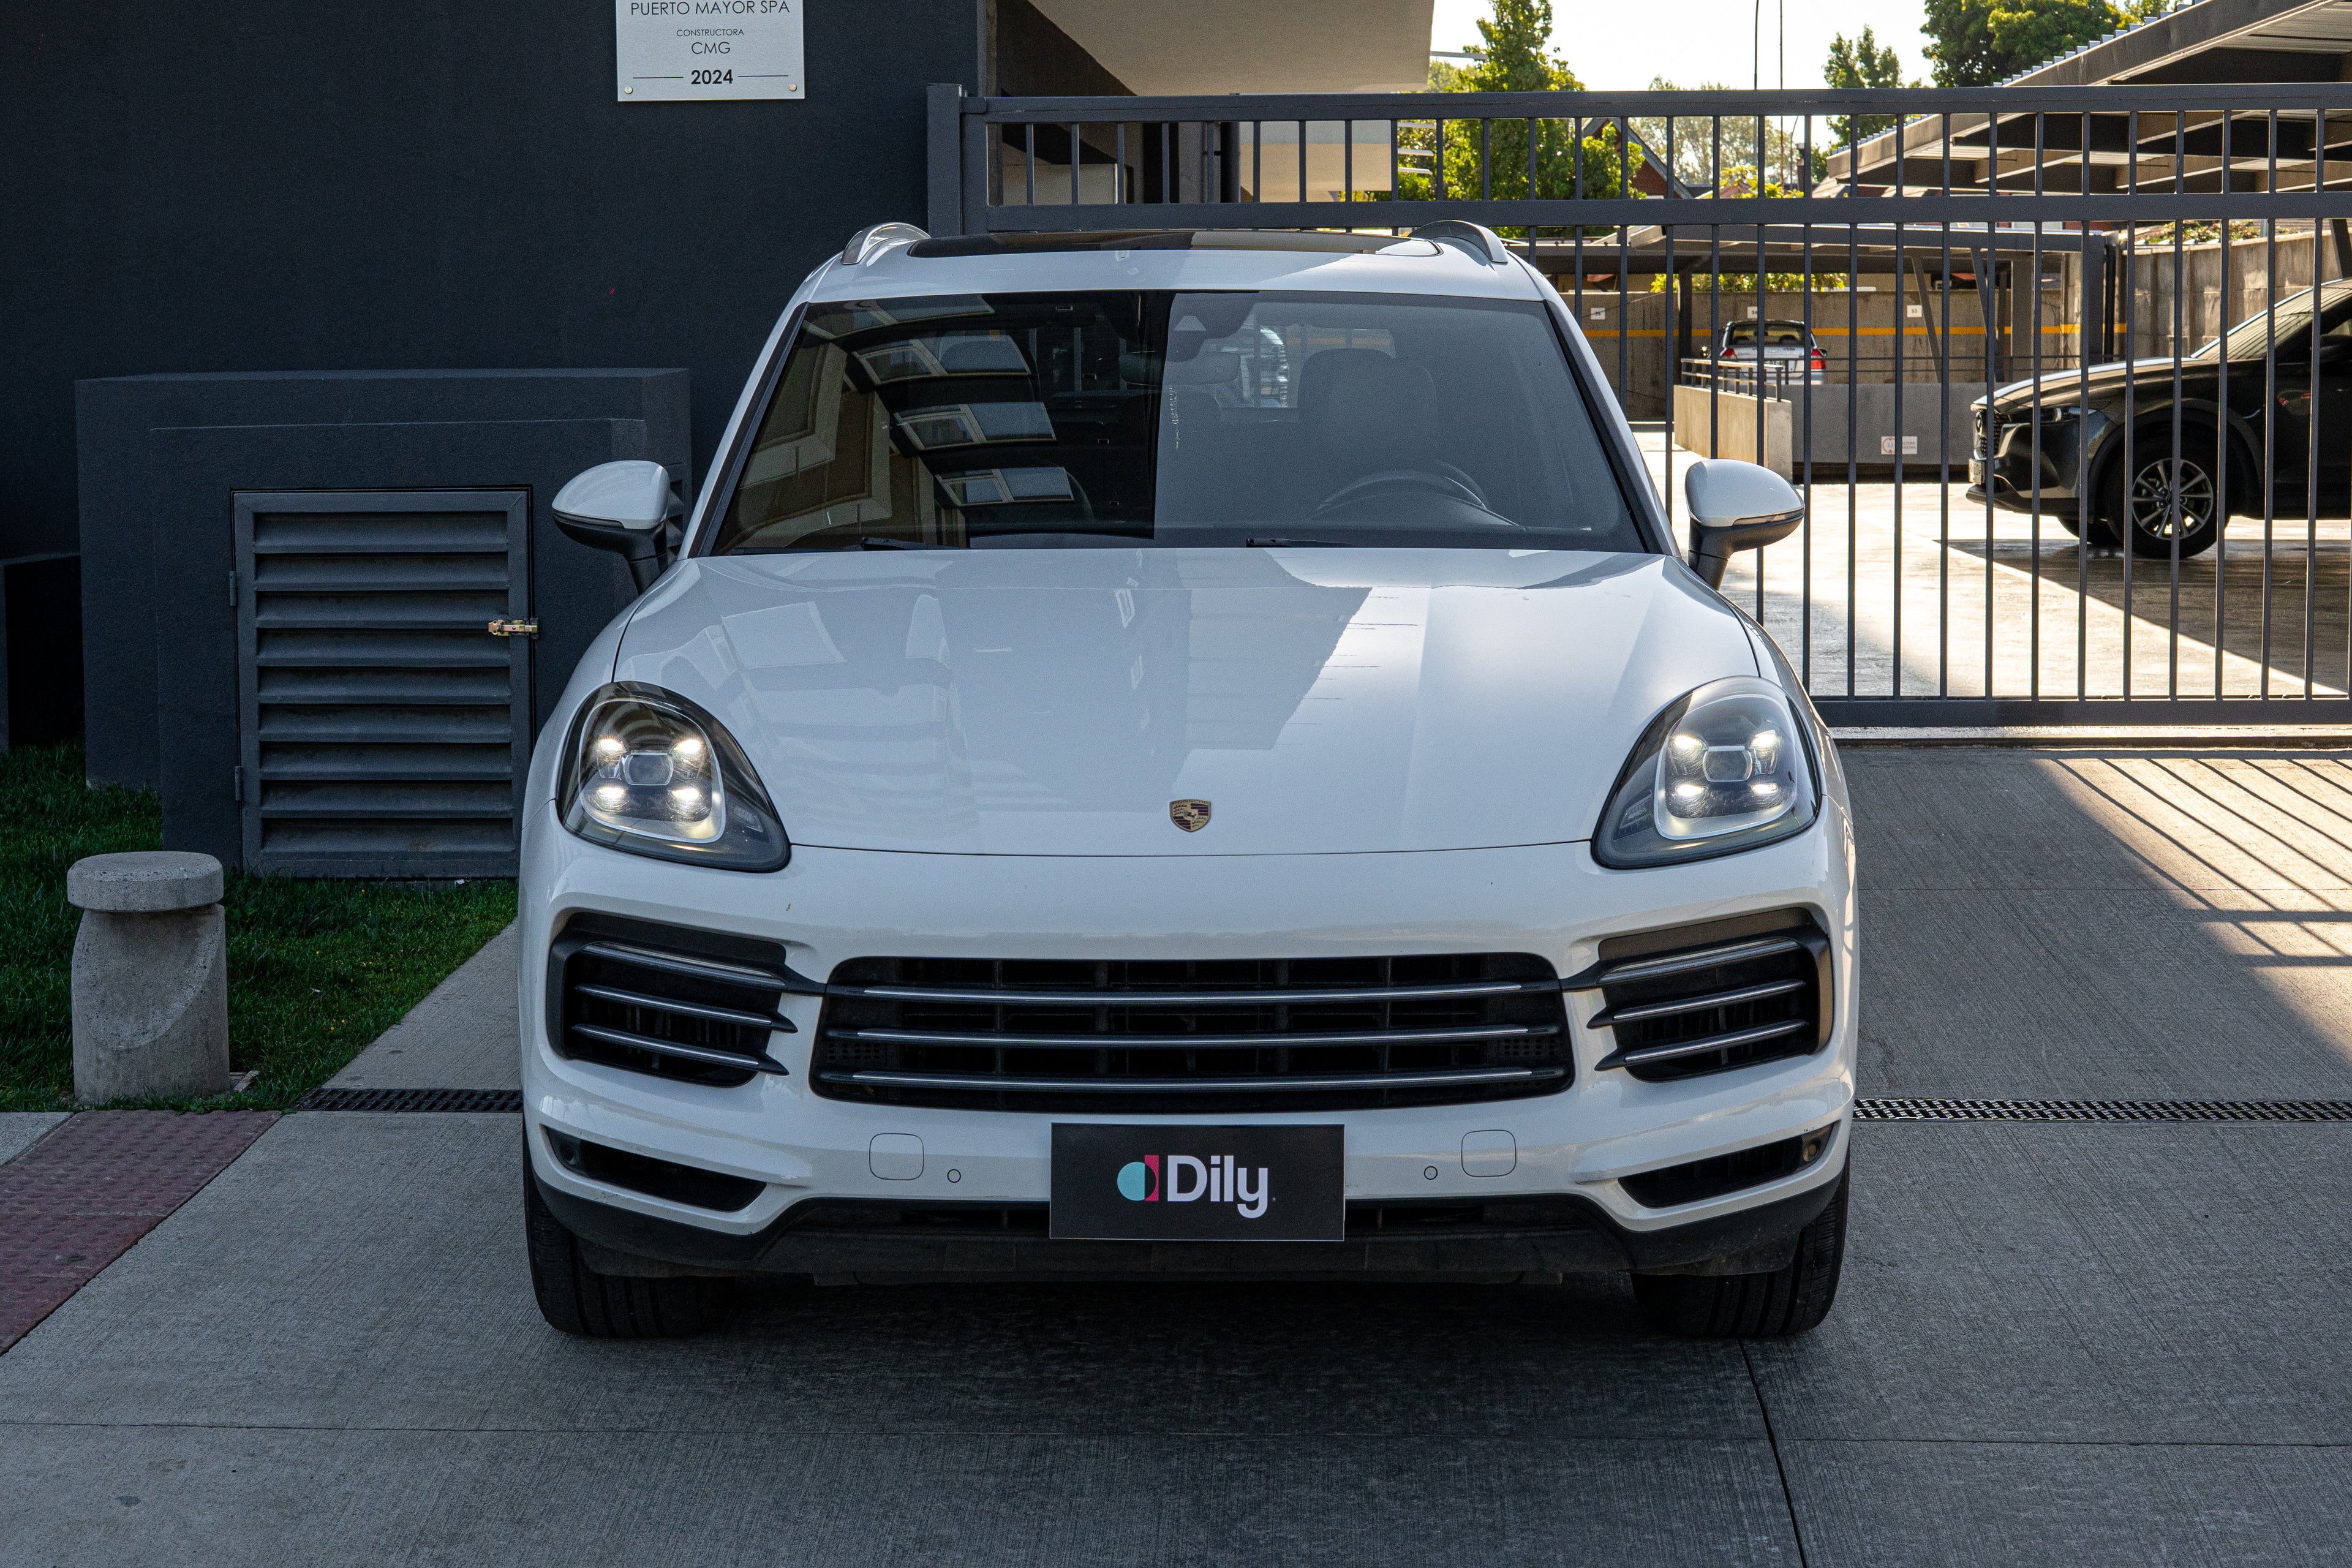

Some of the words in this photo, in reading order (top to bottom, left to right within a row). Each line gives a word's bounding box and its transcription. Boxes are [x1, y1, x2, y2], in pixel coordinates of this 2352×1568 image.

[631, 2, 689, 15] PUERTO
[696, 1, 755, 14] MAYOR
[760, 1, 790, 13] SPA
[691, 42, 731, 54] CMG
[690, 69, 733, 84] 2024
[1167, 1155, 1268, 1218] Dily
